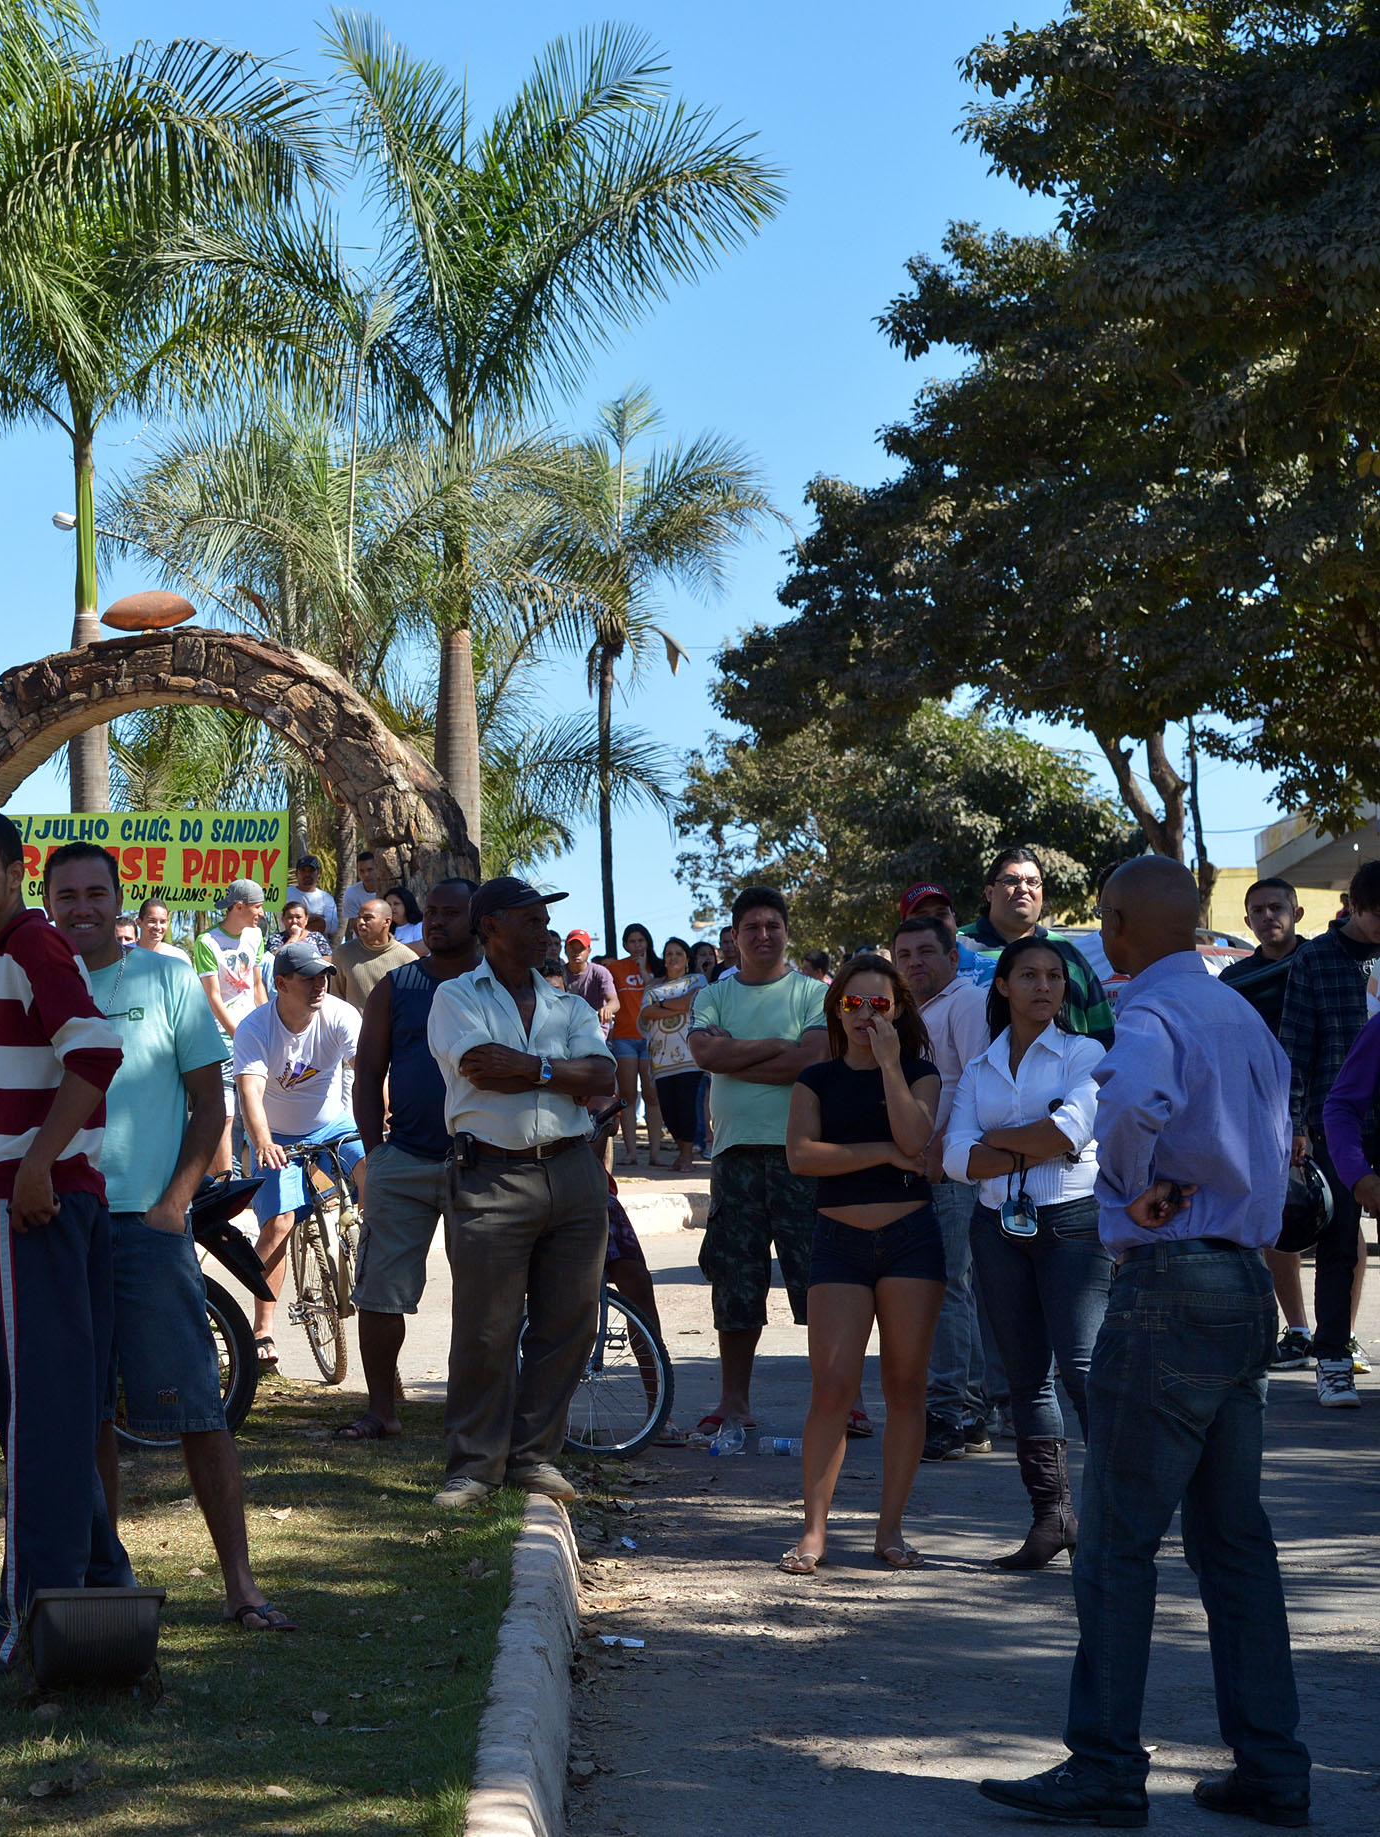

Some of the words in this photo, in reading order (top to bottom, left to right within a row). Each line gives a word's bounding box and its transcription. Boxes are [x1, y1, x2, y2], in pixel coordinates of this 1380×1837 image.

[121, 815, 174, 842] CHÁC.
[180, 818, 203, 842] DO
[211, 818, 280, 844] SANDRO
[181, 848, 281, 885] PARTY
[130, 884, 147, 900] DJ
[150, 885, 208, 902] WILLIANS
